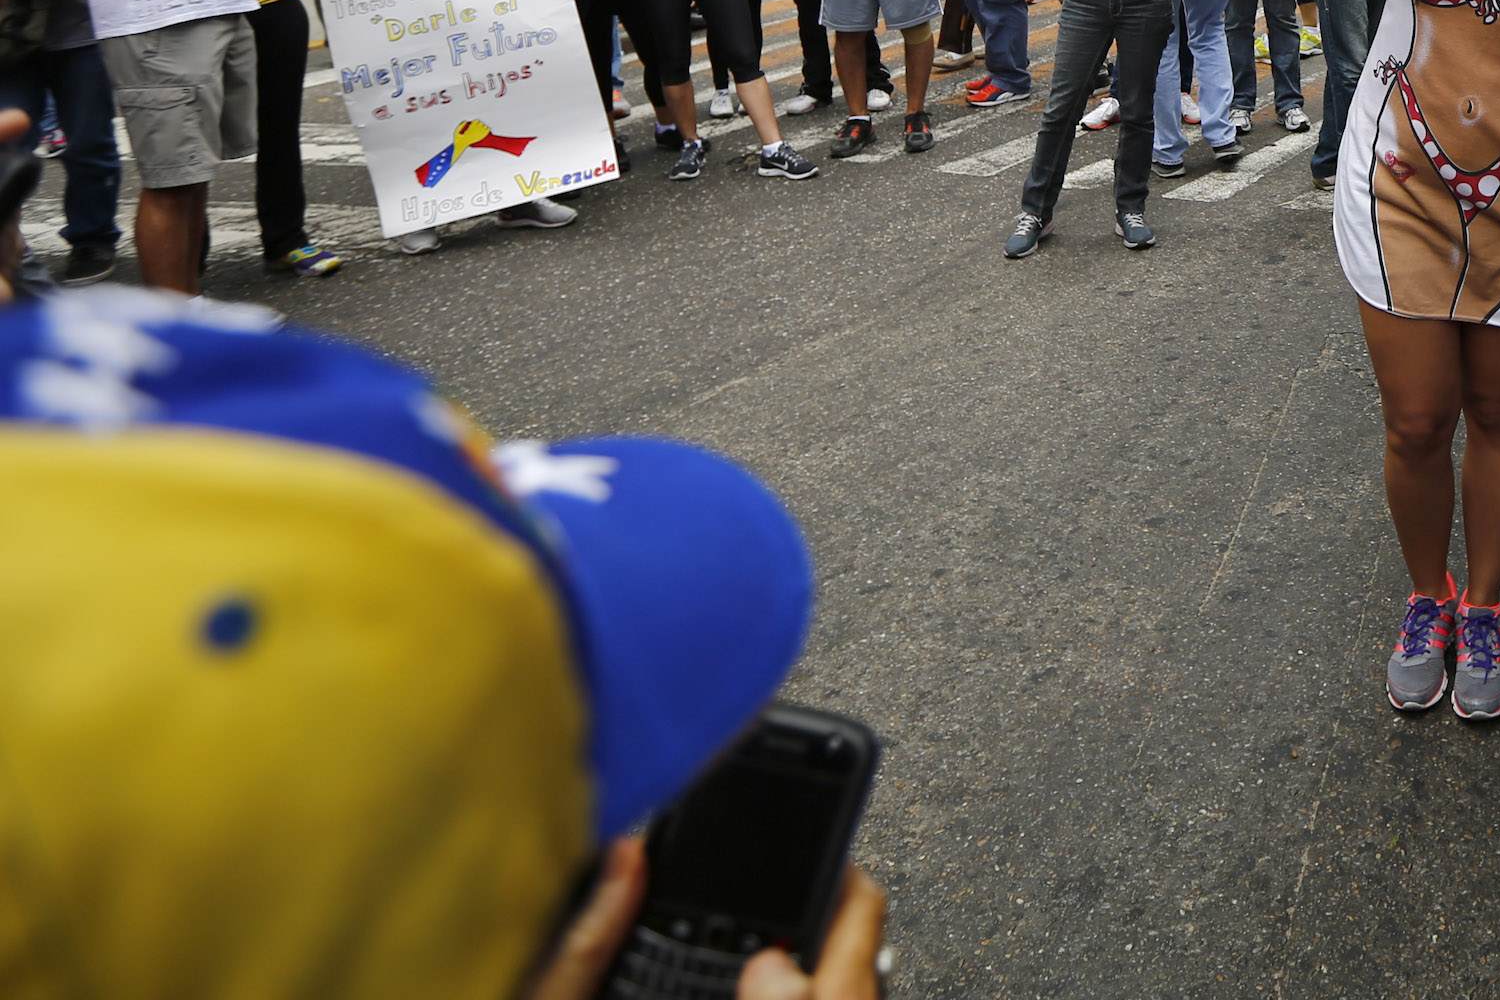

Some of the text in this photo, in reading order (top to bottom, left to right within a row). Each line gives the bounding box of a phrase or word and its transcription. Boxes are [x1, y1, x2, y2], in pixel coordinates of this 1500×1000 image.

[340, 21, 558, 98] Mejor Futuro
[371, 104, 394, 121] a
[405, 89, 453, 113] sus
[400, 159, 617, 225] Hijos de Venezuela
